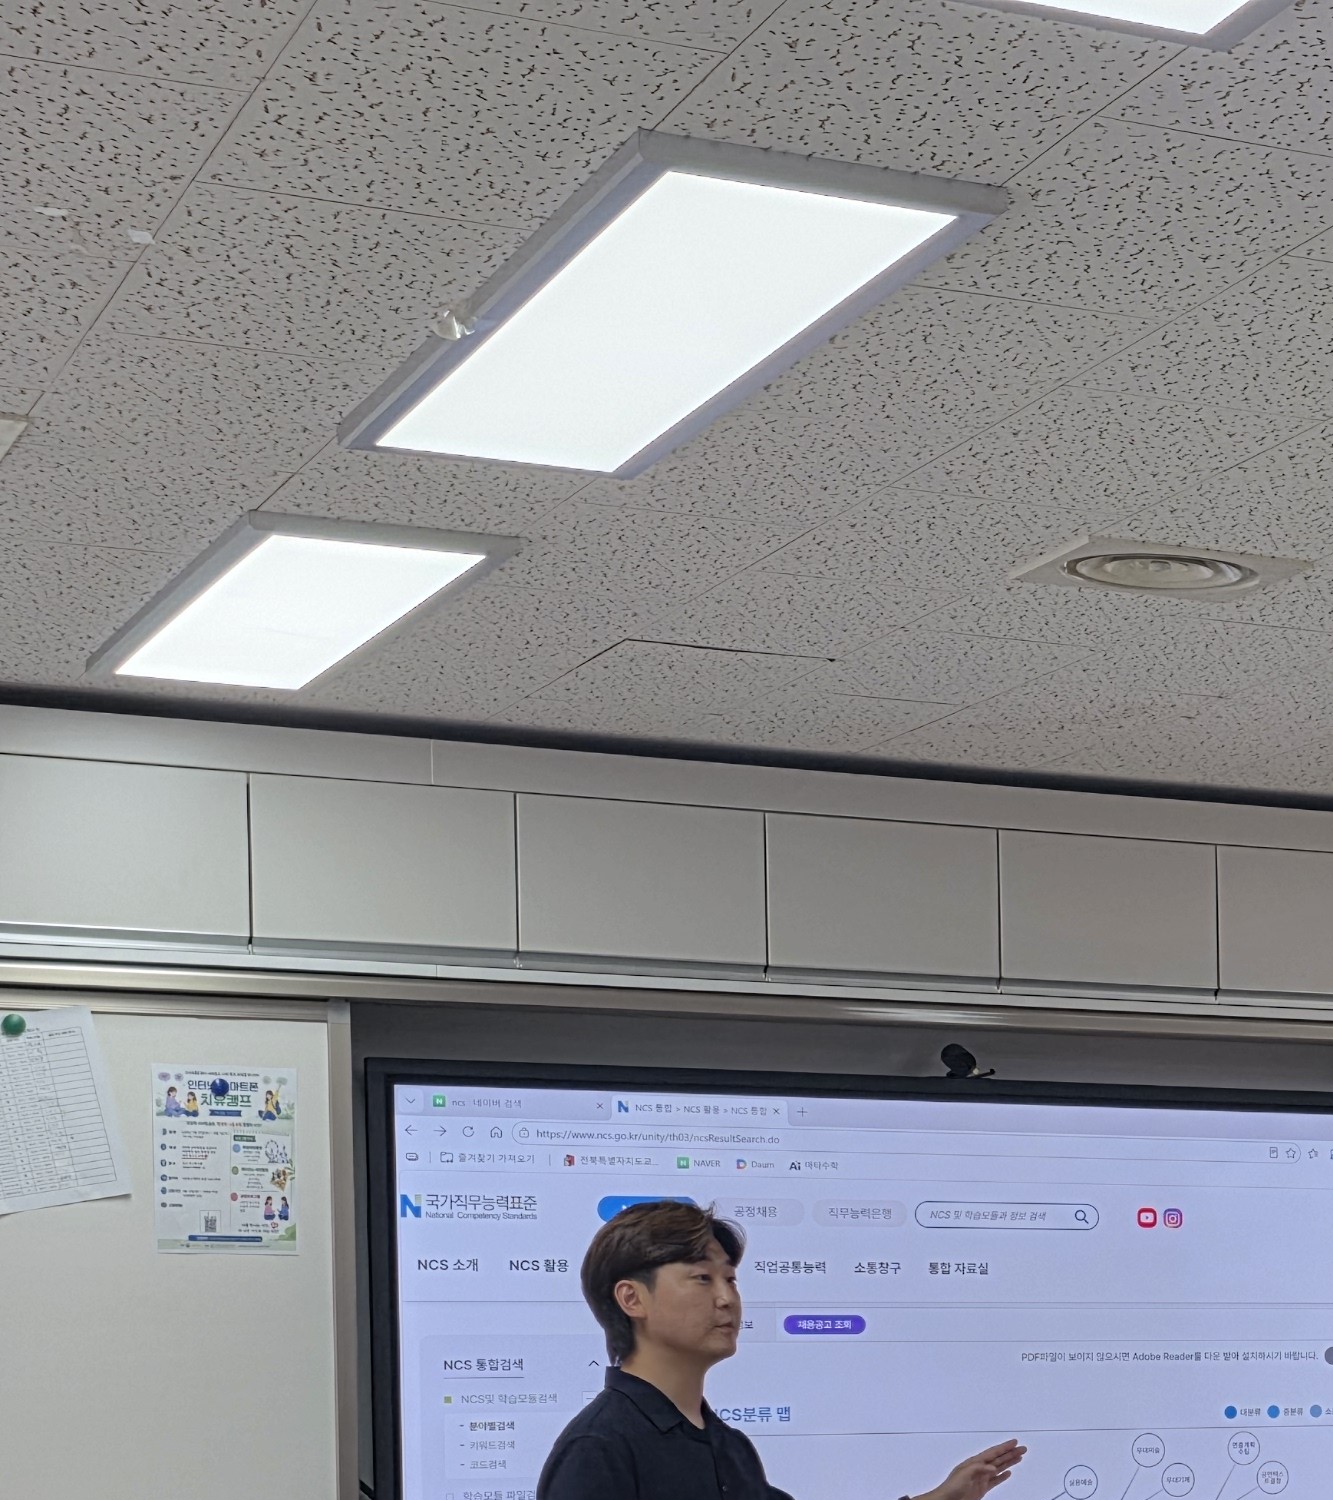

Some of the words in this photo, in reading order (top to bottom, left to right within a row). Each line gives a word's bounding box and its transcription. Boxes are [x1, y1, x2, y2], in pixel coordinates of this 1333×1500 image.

[473, 1098, 500, 1108] 네이버
[504, 1099, 522, 1109] 검색
[635, 1104, 653, 1112] NCS
[684, 1105, 701, 1114] NCS
[731, 1107, 748, 1115] NCS
[536, 1129, 780, 1145] https://www.ncs.go.kr/unity/th03/ncsResultSearch.do
[458, 1153, 495, 1163] 즐겨찾기
[499, 1154, 535, 1164] 가져오기
[693, 1159, 721, 1168] NAVER
[751, 1161, 775, 1169] Daum
[425, 1194, 538, 1211] 국가직무능력표준
[425, 1211, 454, 1219] National
[457, 1212, 500, 1220] Competency
[502, 1212, 538, 1220] Standards
[734, 1206, 778, 1218] 공정채용
[828, 1207, 892, 1220] 직무능력은행
[930, 1210, 951, 1219] NCS
[1029, 1211, 1047, 1221] 검색
[417, 1259, 449, 1271] NCS
[452, 1258, 479, 1272] 소개
[509, 1259, 540, 1271] NCS
[543, 1259, 570, 1273] 활용
[754, 1260, 827, 1275] 직업공통능력
[854, 1261, 902, 1275] 소통창구
[928, 1262, 951, 1275] 통합
[954, 1262, 989, 1275] 자료실
[1132, 1352, 1161, 1362] Adobe
[443, 1360, 472, 1371] NCS
[476, 1358, 524, 1371] 통합검색
[714, 1406, 773, 1422] CS분류
[776, 1406, 791, 1422] 맵
[506, 1490, 536, 1500] 파일검
